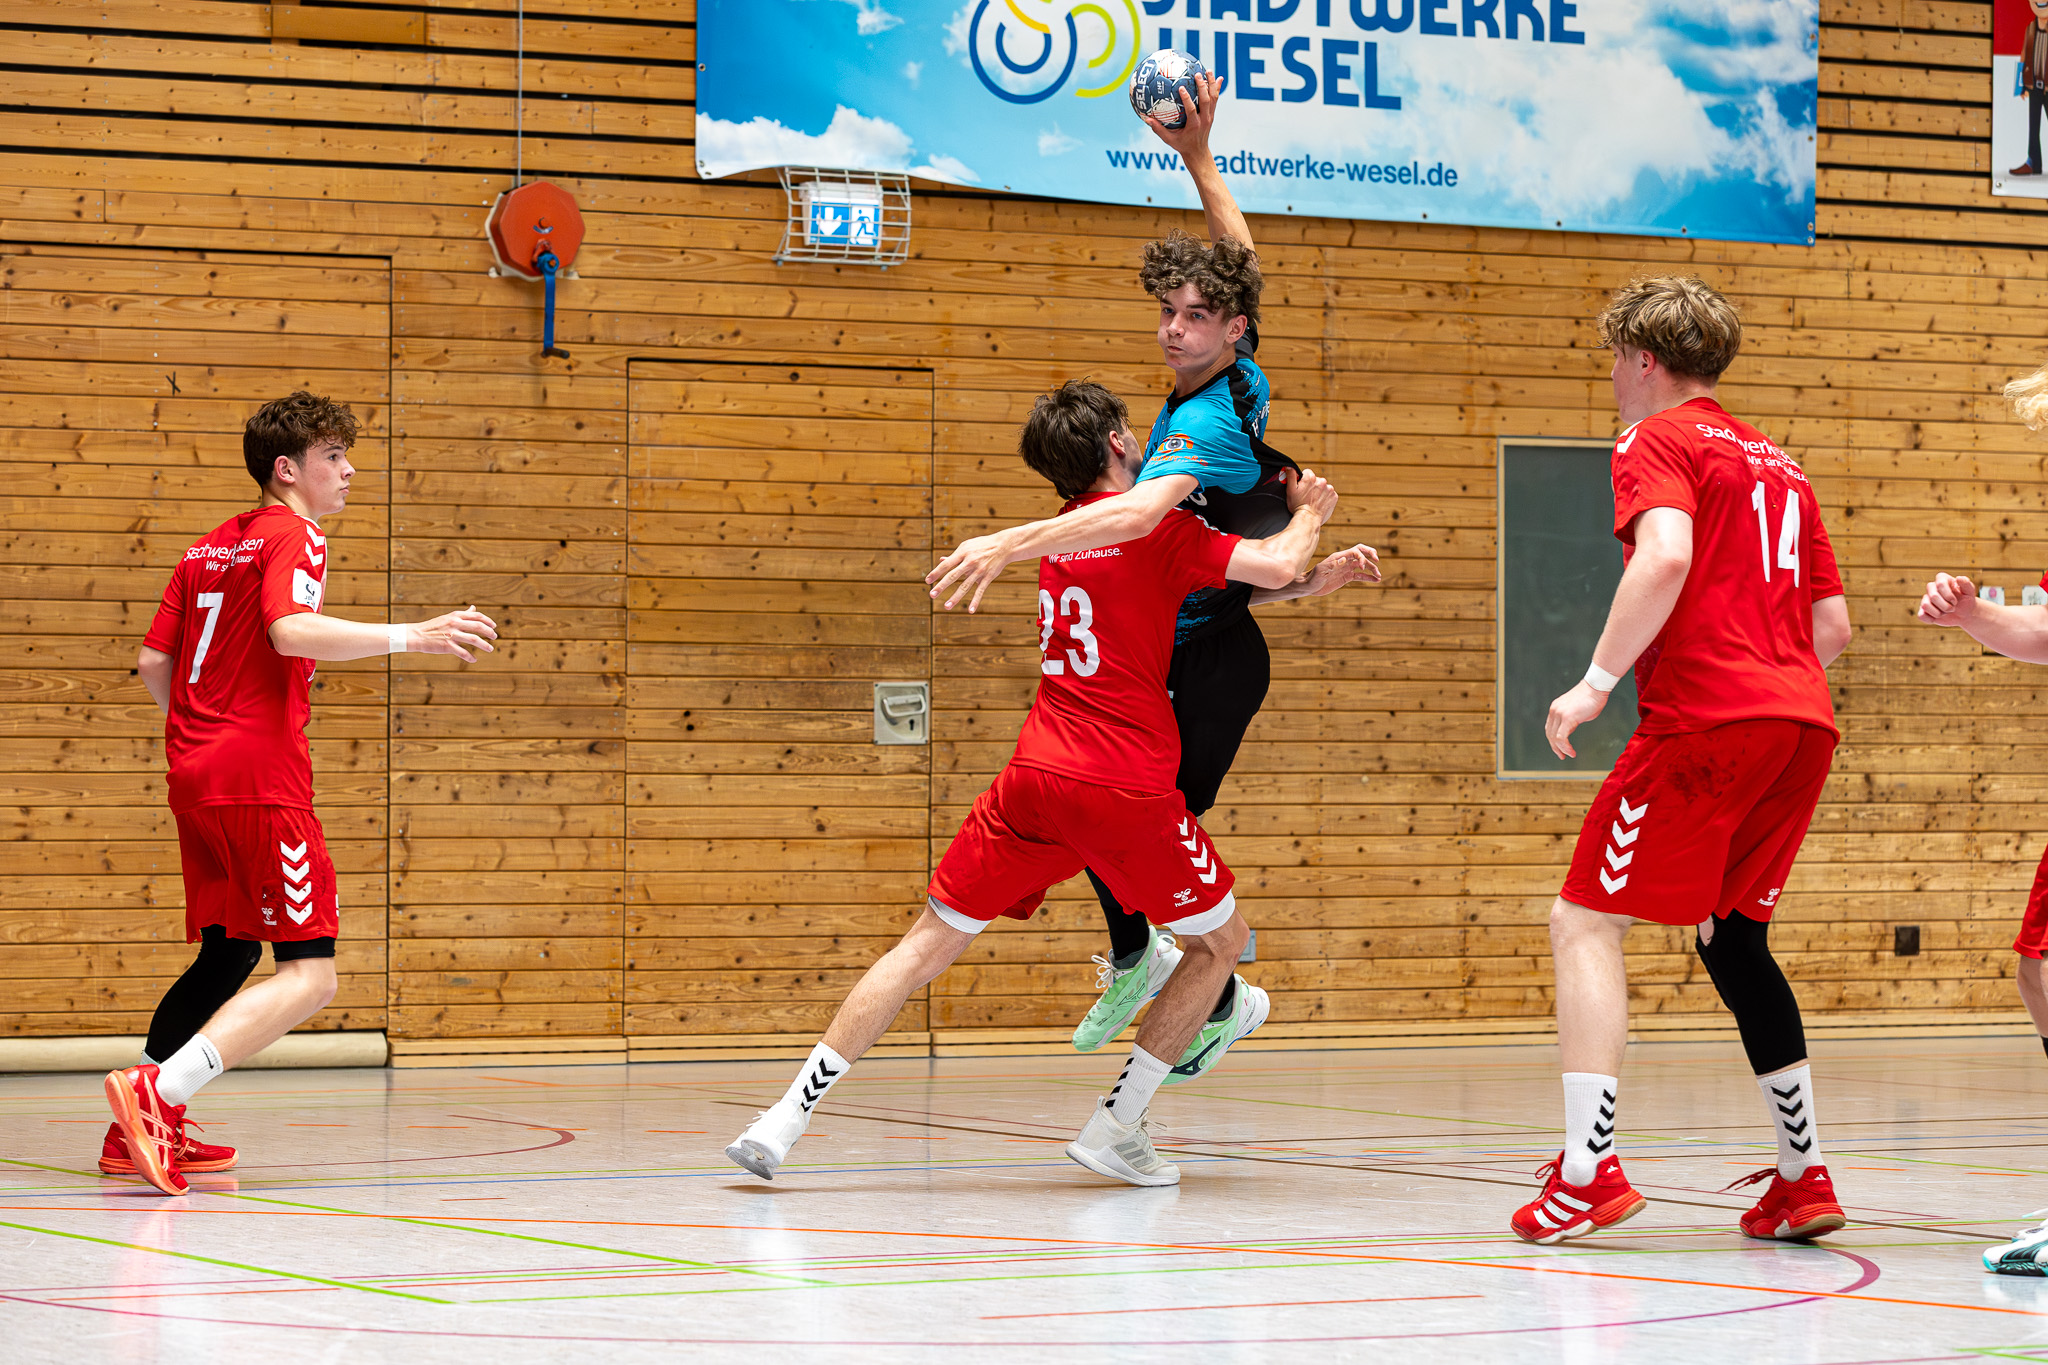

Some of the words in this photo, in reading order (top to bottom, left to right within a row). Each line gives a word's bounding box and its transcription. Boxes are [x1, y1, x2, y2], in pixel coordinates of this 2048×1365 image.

[1106, 150, 1458, 187] www.adtwerke-wesel.de
[205, 560, 220, 572] Wir
[1074, 547, 1123, 560] Zuhause.
[1751, 480, 1799, 588] 14
[188, 592, 224, 684] 7
[1038, 586, 1100, 677] 23
